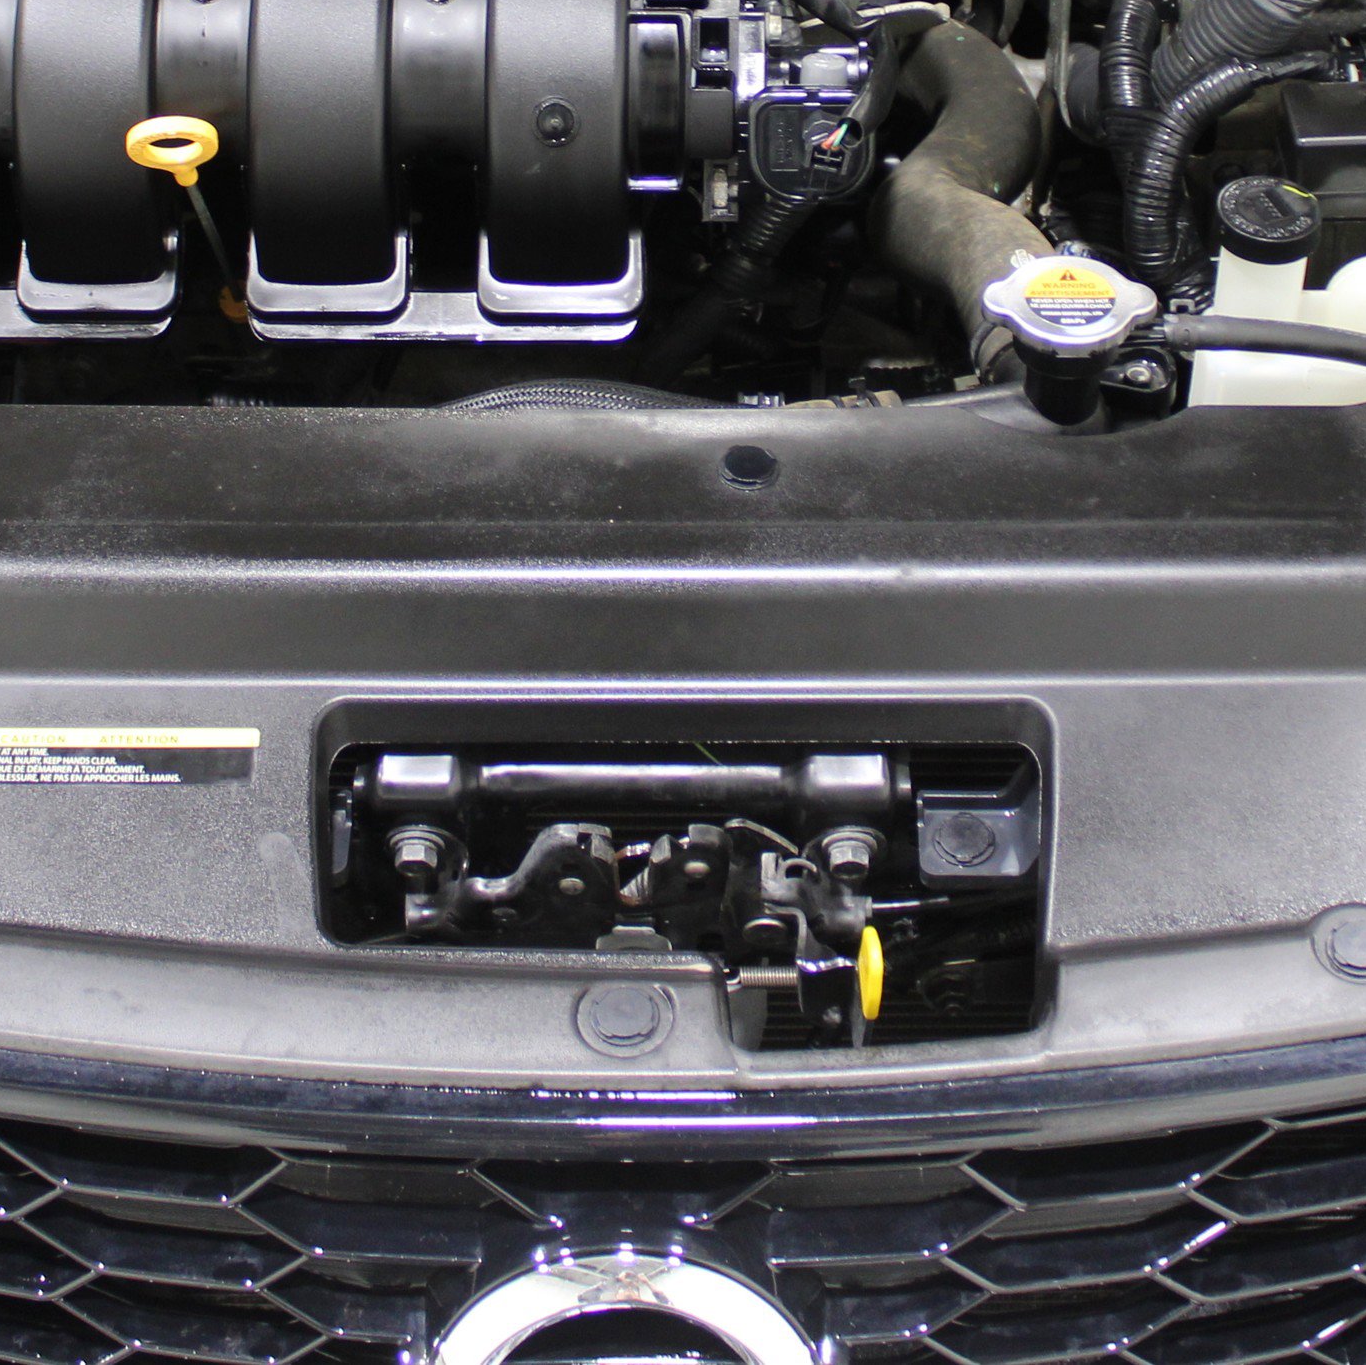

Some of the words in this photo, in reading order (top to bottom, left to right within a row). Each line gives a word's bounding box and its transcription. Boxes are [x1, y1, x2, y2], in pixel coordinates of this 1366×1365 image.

[0, 734, 66, 744] CAUTION
[100, 734, 179, 744] ATTENTION
[1, 746, 12, 755] AT
[12, 746, 29, 755] ANY
[29, 746, 49, 755] TIME.
[14, 756, 42, 765] INJURY,
[43, 756, 62, 765] KEEP
[62, 756, 90, 765] HANDS
[91, 756, 118, 765] CLEAR.
[13, 764, 26, 774] DE
[26, 764, 73, 774] DÉMARRER
[81, 764, 104, 774] TOUT
[105, 764, 146, 774] MOMENT.
[40, 773, 53, 782] NE
[53, 773, 70, 782] PAS
[70, 773, 83, 782] EN
[83, 773, 135, 782] APPROCHER
[135, 773, 150, 782] LES
[150, 773, 182, 782] MAINS.
